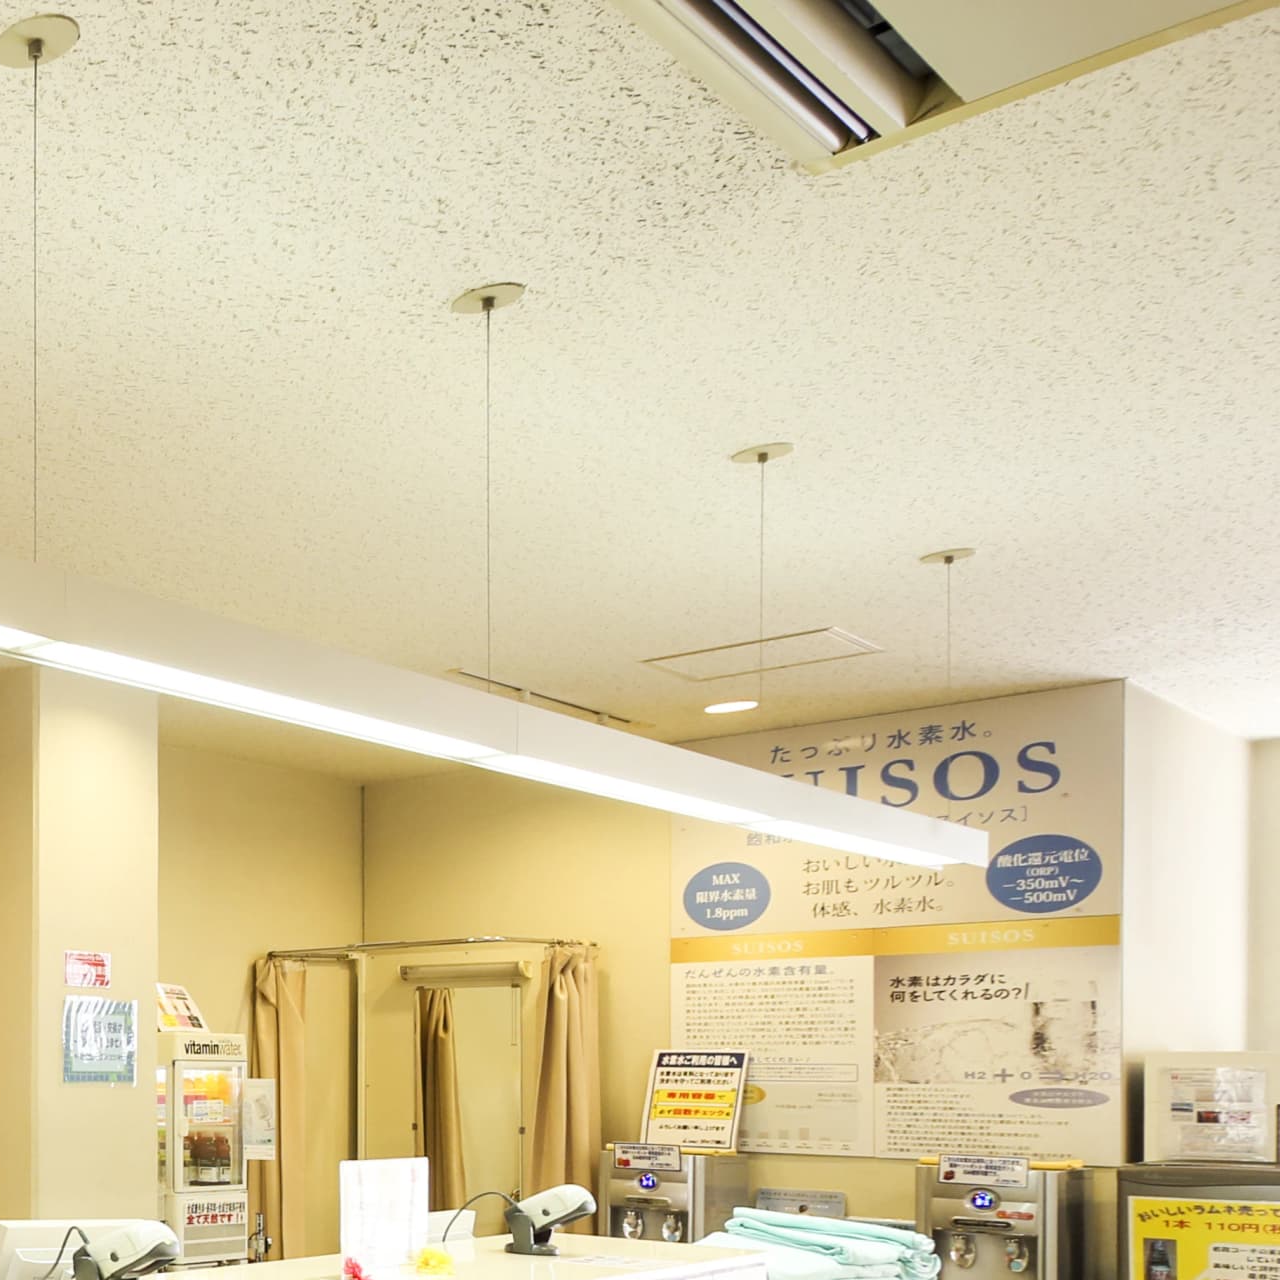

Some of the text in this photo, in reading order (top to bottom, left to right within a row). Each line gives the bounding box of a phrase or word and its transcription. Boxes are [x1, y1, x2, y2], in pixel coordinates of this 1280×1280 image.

[780, 741, 1061, 807] ISOS
[712, 873, 741, 886] MAX
[802, 871, 955, 896] お肌もツルツル。
[705, 906, 749, 921] 1.8ppm
[946, 928, 1035, 945] SUISOS
[731, 939, 805, 955] SUISOS
[889, 973, 1006, 989] 水素はカラダに
[964, 1071, 987, 1080] H2
